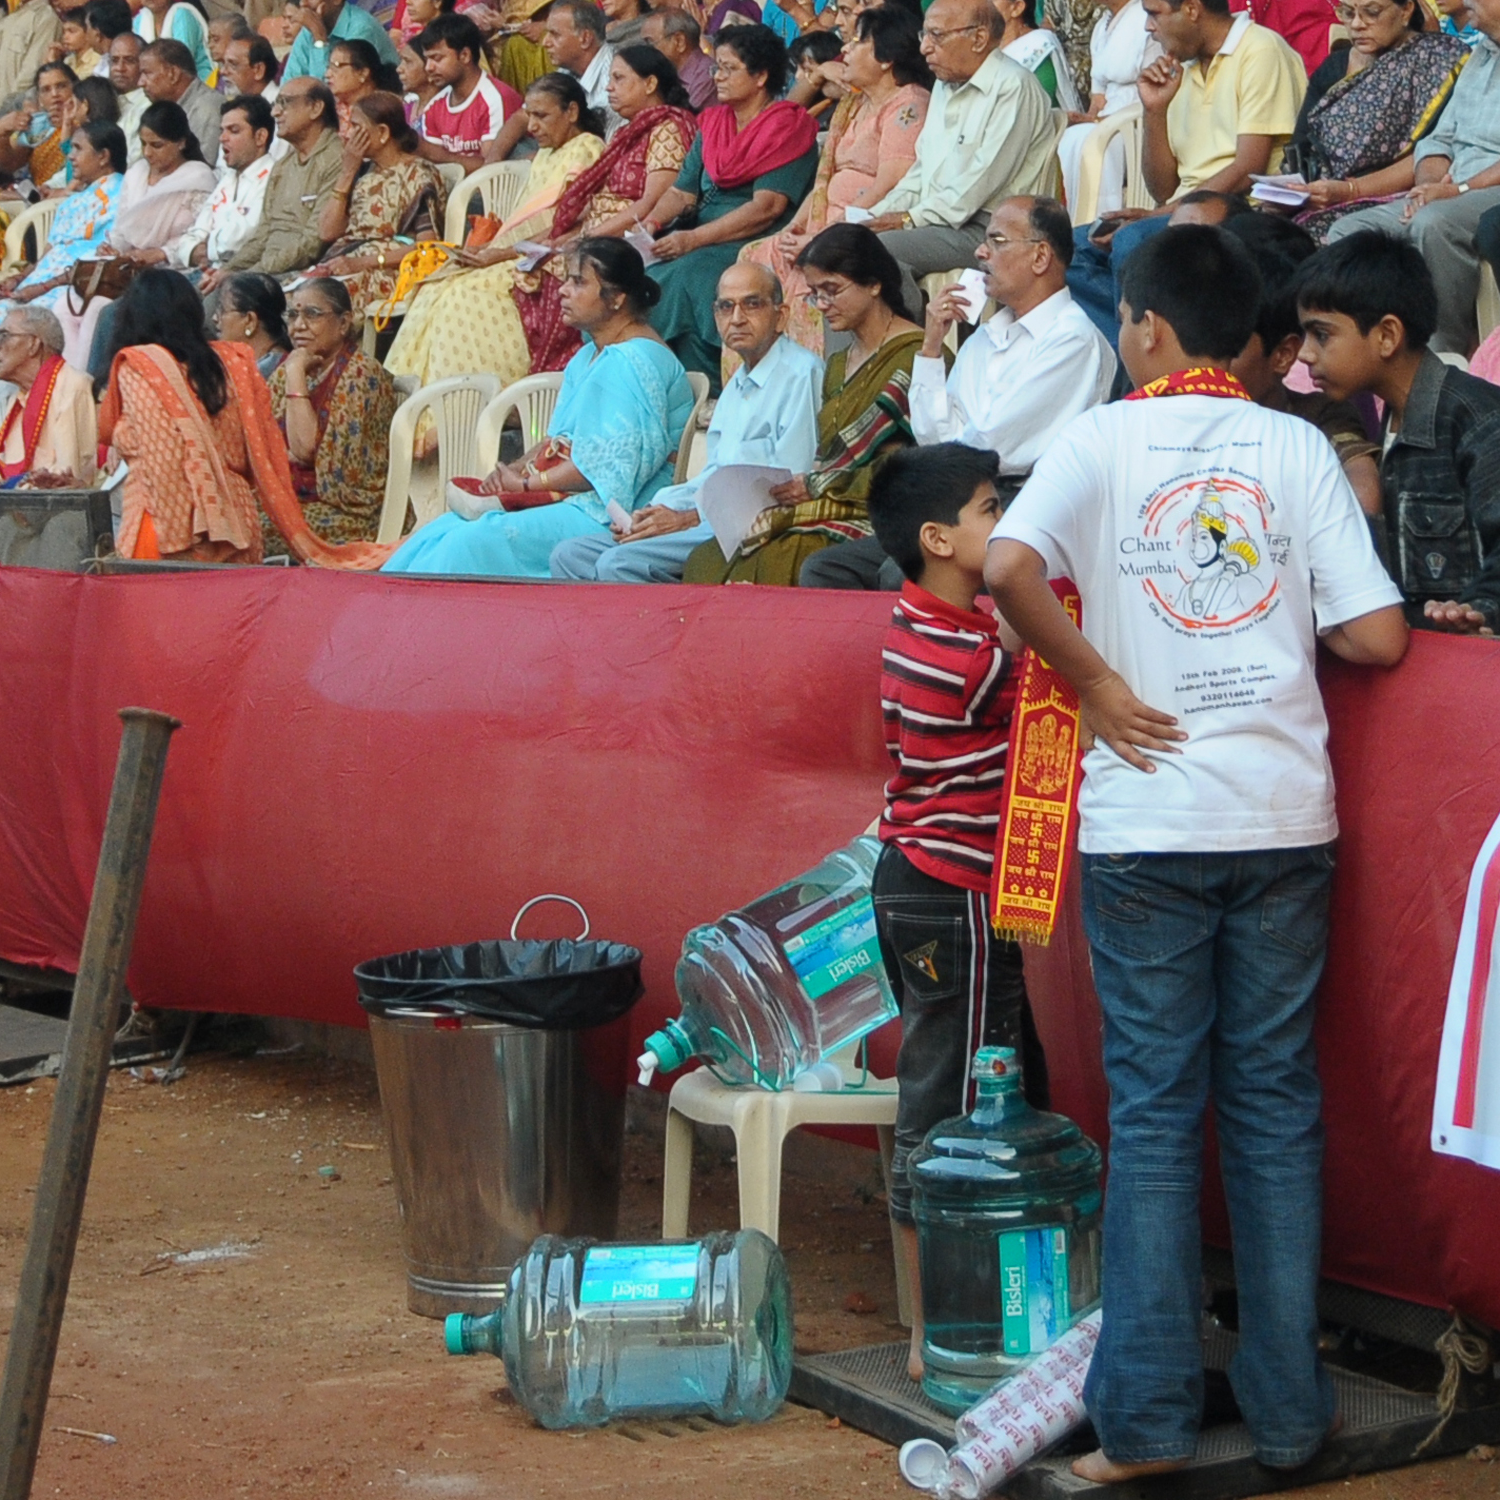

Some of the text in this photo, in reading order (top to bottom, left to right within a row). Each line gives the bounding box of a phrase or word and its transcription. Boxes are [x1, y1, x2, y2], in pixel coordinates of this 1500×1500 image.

[1119, 536, 1172, 555] Chant
[1118, 560, 1177, 578] Mumbai
[1148, 601, 1160, 618] City
[1161, 615, 1174, 630] that
[1200, 630, 1232, 640] together
[1174, 682, 1207, 693] Andheri
[1209, 678, 1237, 688] Sports
[829, 949, 872, 983] Bisleri
[611, 1283, 659, 1299] Bisleri
[1003, 1266, 1023, 1317] Bisleri
[970, 1445, 993, 1472] Tulsi
